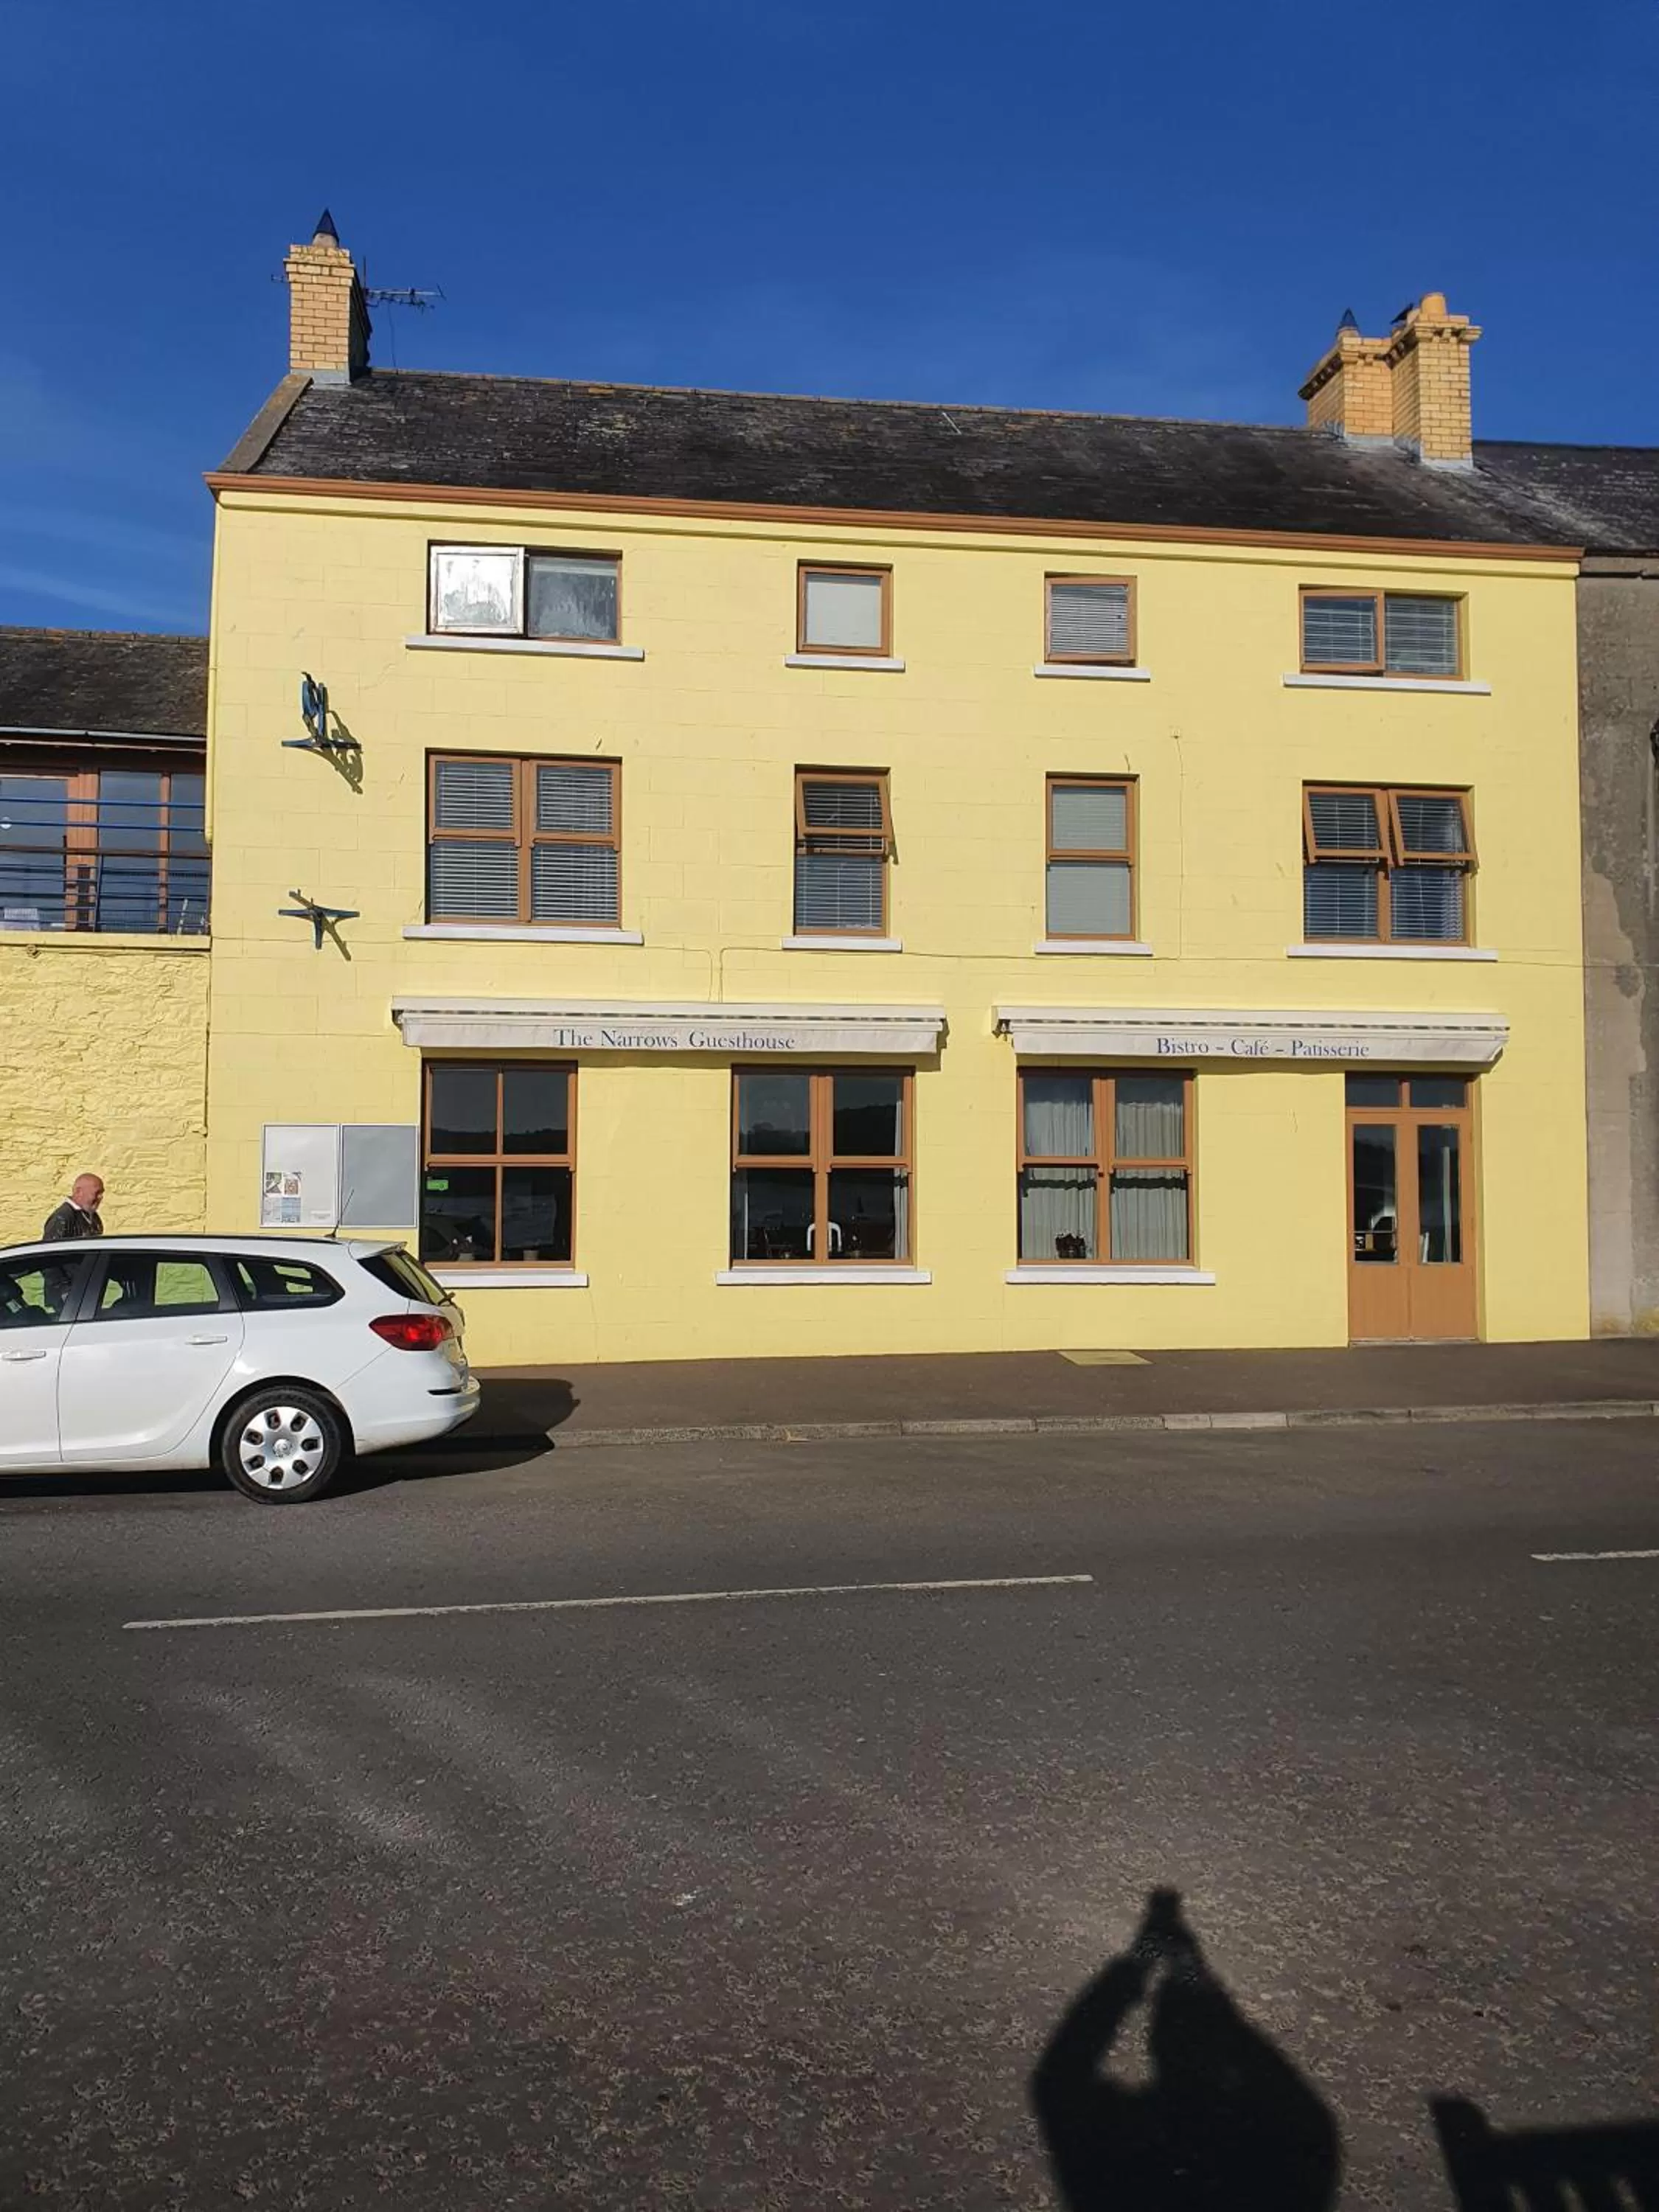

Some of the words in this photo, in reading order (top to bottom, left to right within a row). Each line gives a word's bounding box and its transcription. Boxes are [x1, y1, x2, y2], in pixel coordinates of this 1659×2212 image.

[554, 1029, 593, 1046] The
[601, 1030, 678, 1047] Narrows
[689, 1032, 796, 1049] Guesthouse
[1156, 1037, 1208, 1054] Bistro
[1231, 1039, 1269, 1055] Café
[1292, 1040, 1369, 1057] Patisserie
